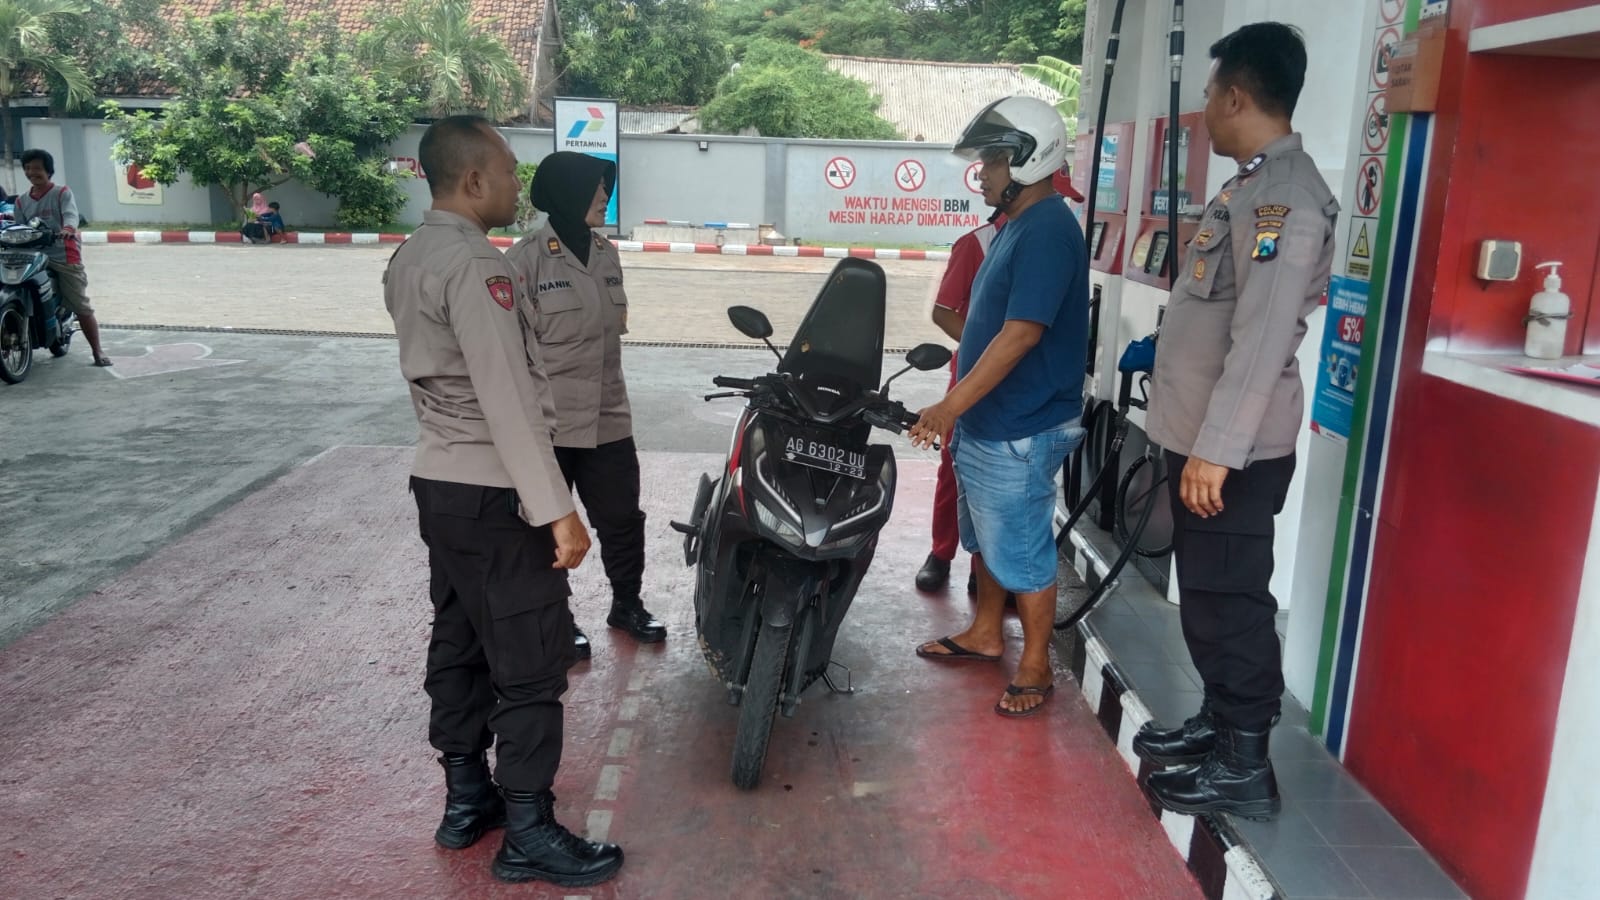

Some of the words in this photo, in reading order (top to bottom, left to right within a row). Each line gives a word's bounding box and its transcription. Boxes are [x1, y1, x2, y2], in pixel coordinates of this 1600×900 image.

[565, 140, 607, 149] PERTAMINA
[844, 196, 887, 211] WAKTU
[892, 197, 941, 212] MENGISI
[944, 199, 970, 213] BBM
[829, 211, 866, 225] MESIN
[870, 212, 913, 225] HARAP
[917, 213, 979, 227] DIMATIKAN
[539, 280, 573, 292] NANIK
[1342, 318, 1361, 342] 5%
[817, 386, 841, 396] HONDA
[786, 437, 804, 452] AG
[808, 441, 845, 463] 6302
